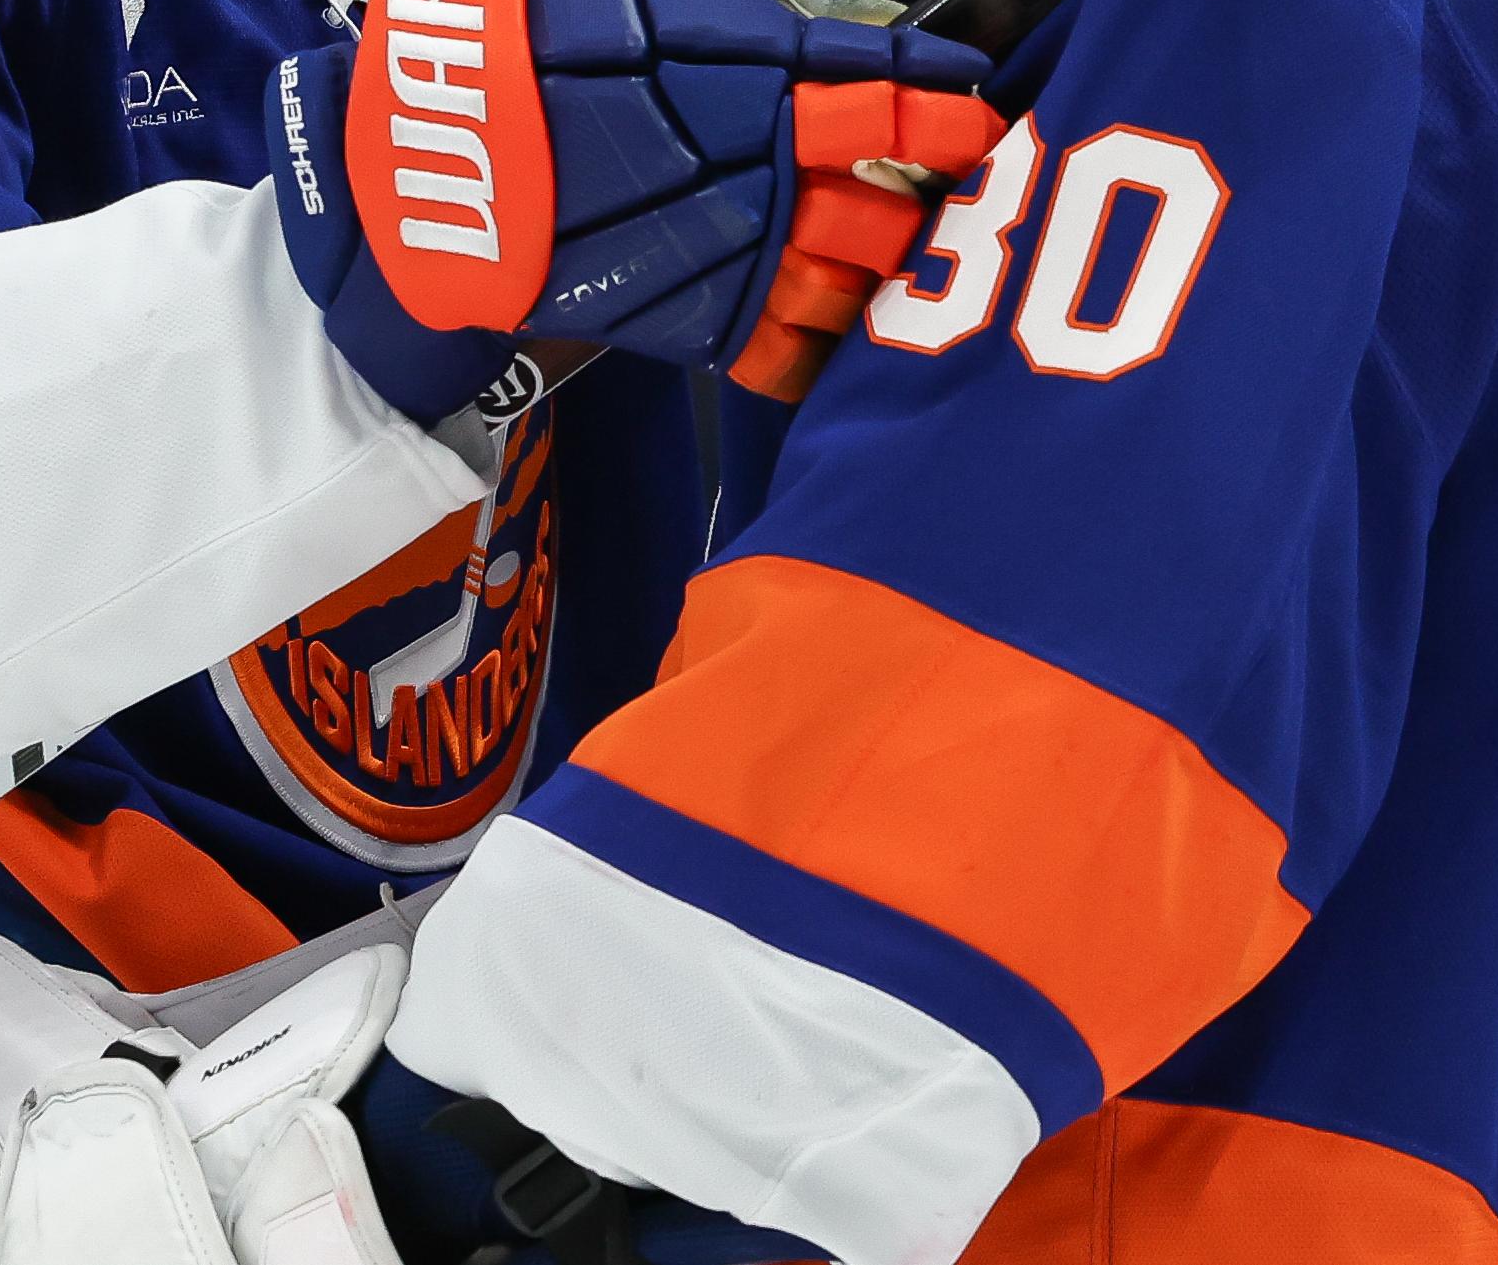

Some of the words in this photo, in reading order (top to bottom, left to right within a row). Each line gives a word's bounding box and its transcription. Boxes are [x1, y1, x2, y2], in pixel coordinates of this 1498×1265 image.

[279, 56, 324, 215] SCHAEFER
[555, 248, 659, 313] COVER
[864, 110, 1232, 382] 30
